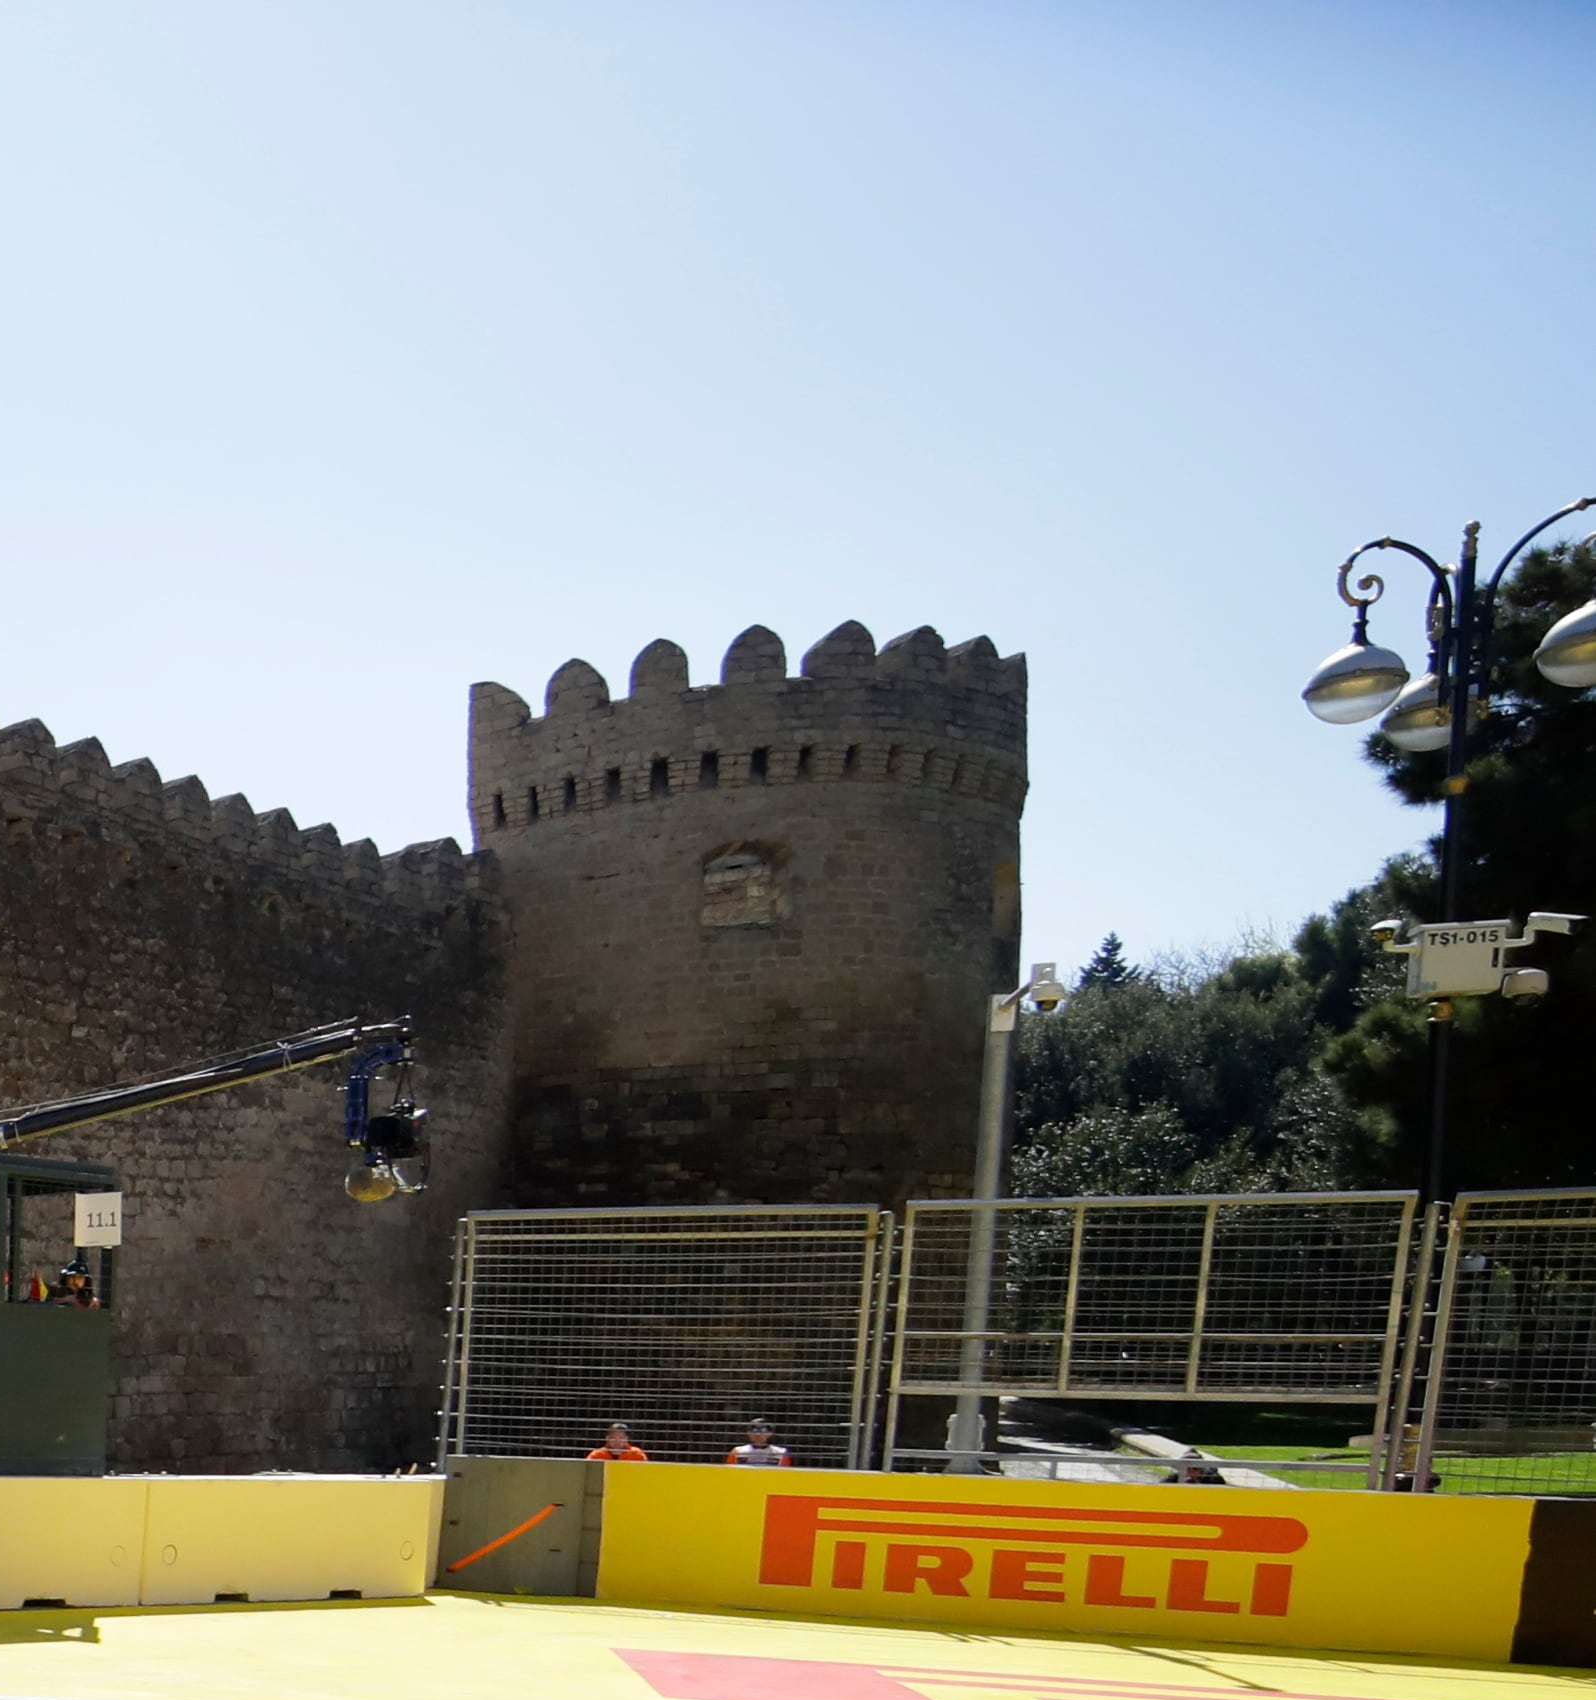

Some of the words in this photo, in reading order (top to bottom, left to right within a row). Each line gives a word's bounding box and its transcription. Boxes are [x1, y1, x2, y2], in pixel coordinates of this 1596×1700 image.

[1428, 929, 1498, 946] TS1-015
[87, 1211, 117, 1228] 11.1
[758, 1494, 1309, 1617] PIRELLI
